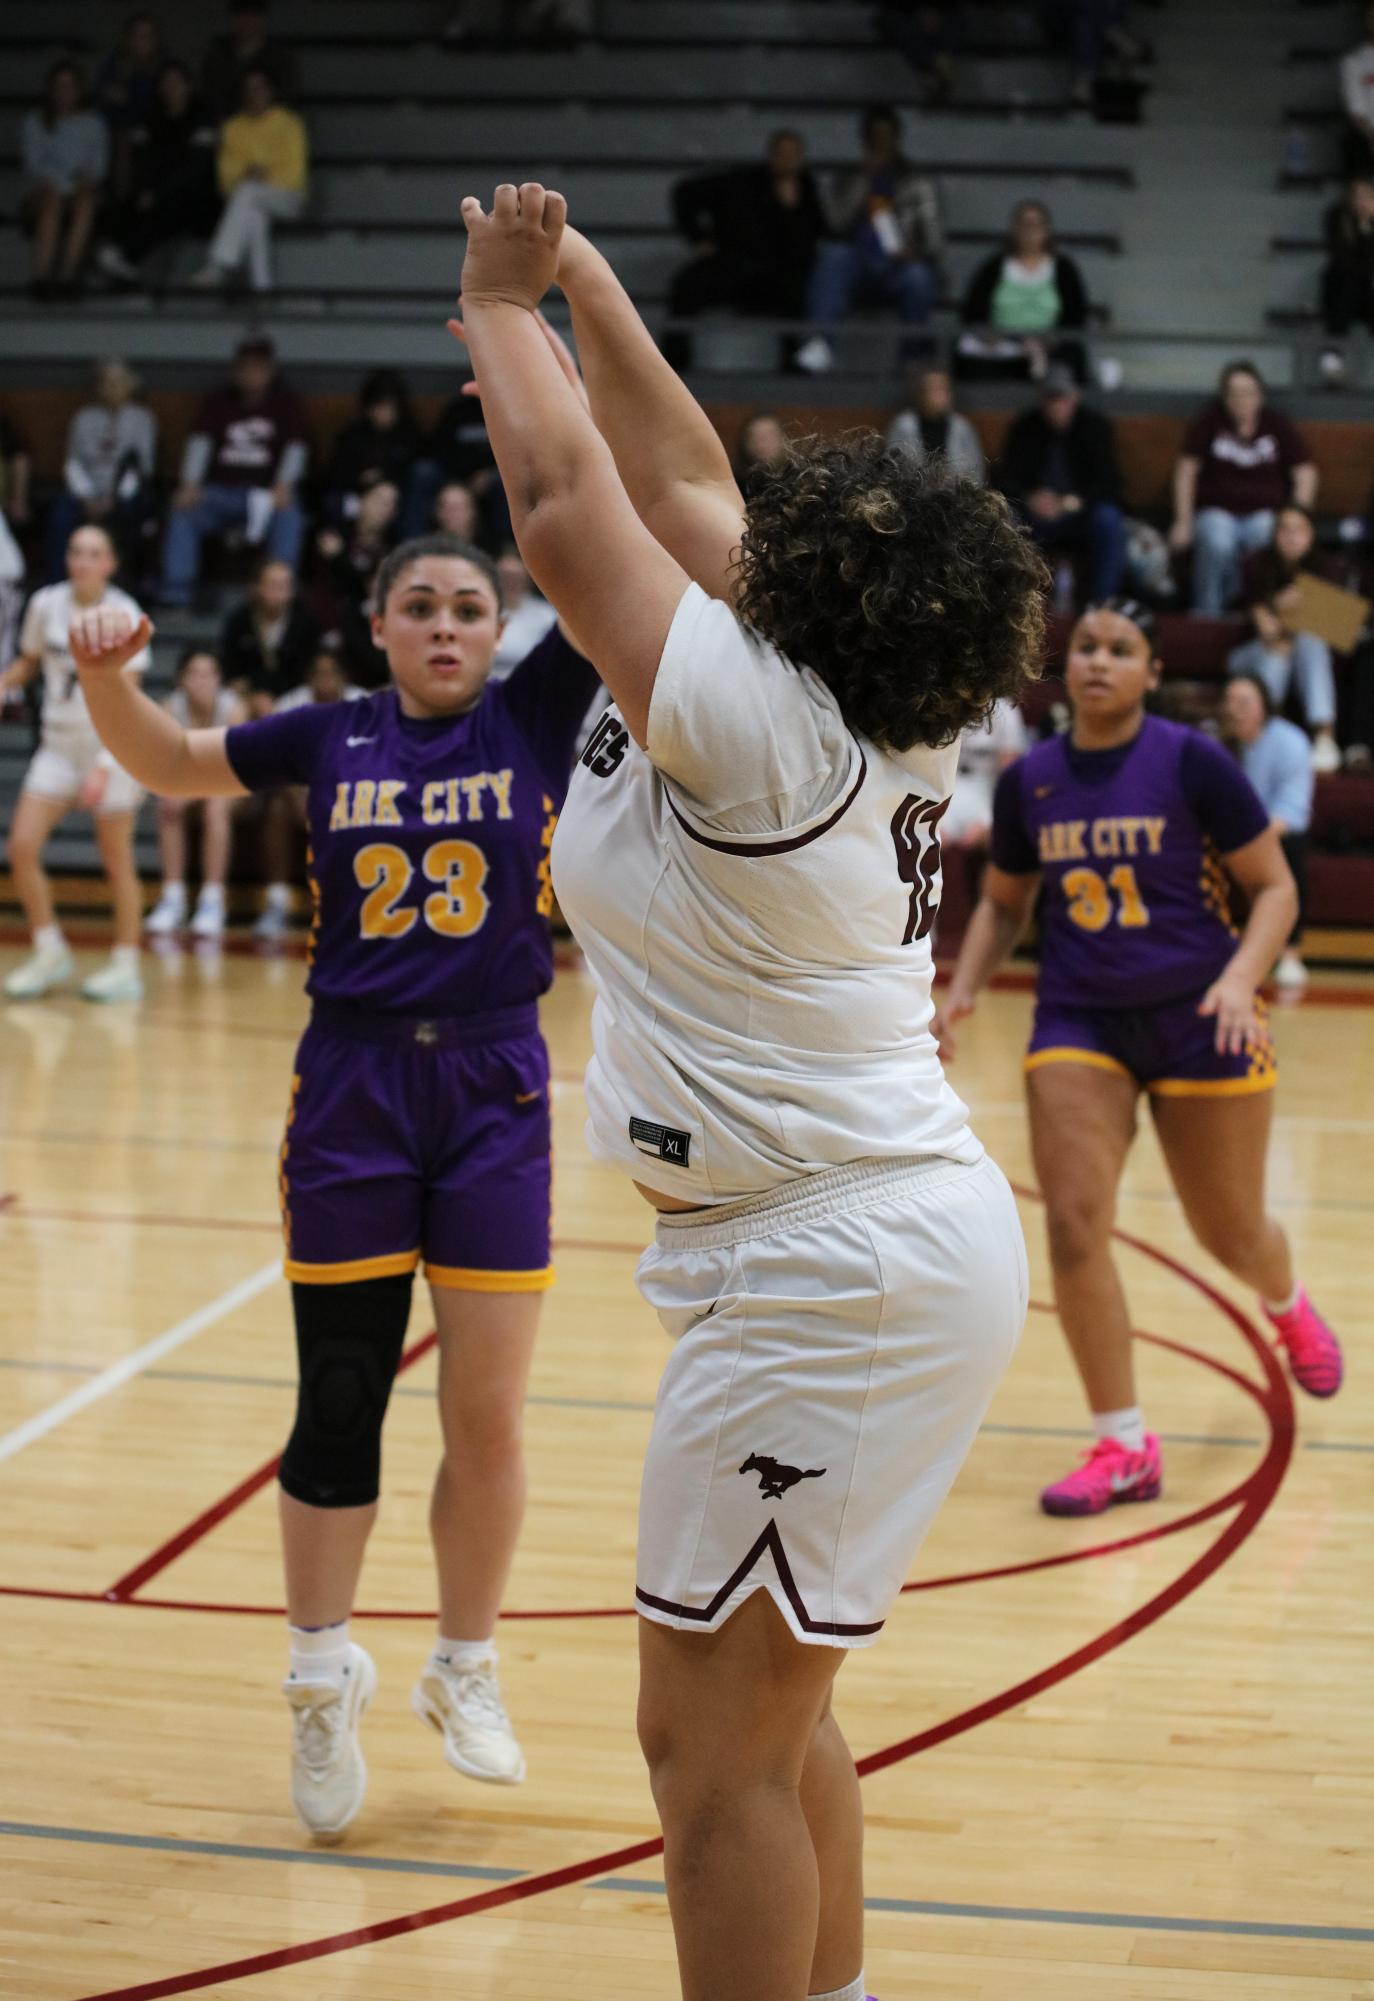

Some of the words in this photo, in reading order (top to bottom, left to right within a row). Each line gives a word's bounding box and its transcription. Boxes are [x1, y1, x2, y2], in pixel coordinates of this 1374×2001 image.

[329, 780, 407, 831] ARK
[421, 769, 514, 825] CITY
[1091, 815, 1167, 857] CITY
[353, 839, 491, 939] 23
[1061, 863, 1151, 933] 31
[665, 1138, 682, 1156] XL
